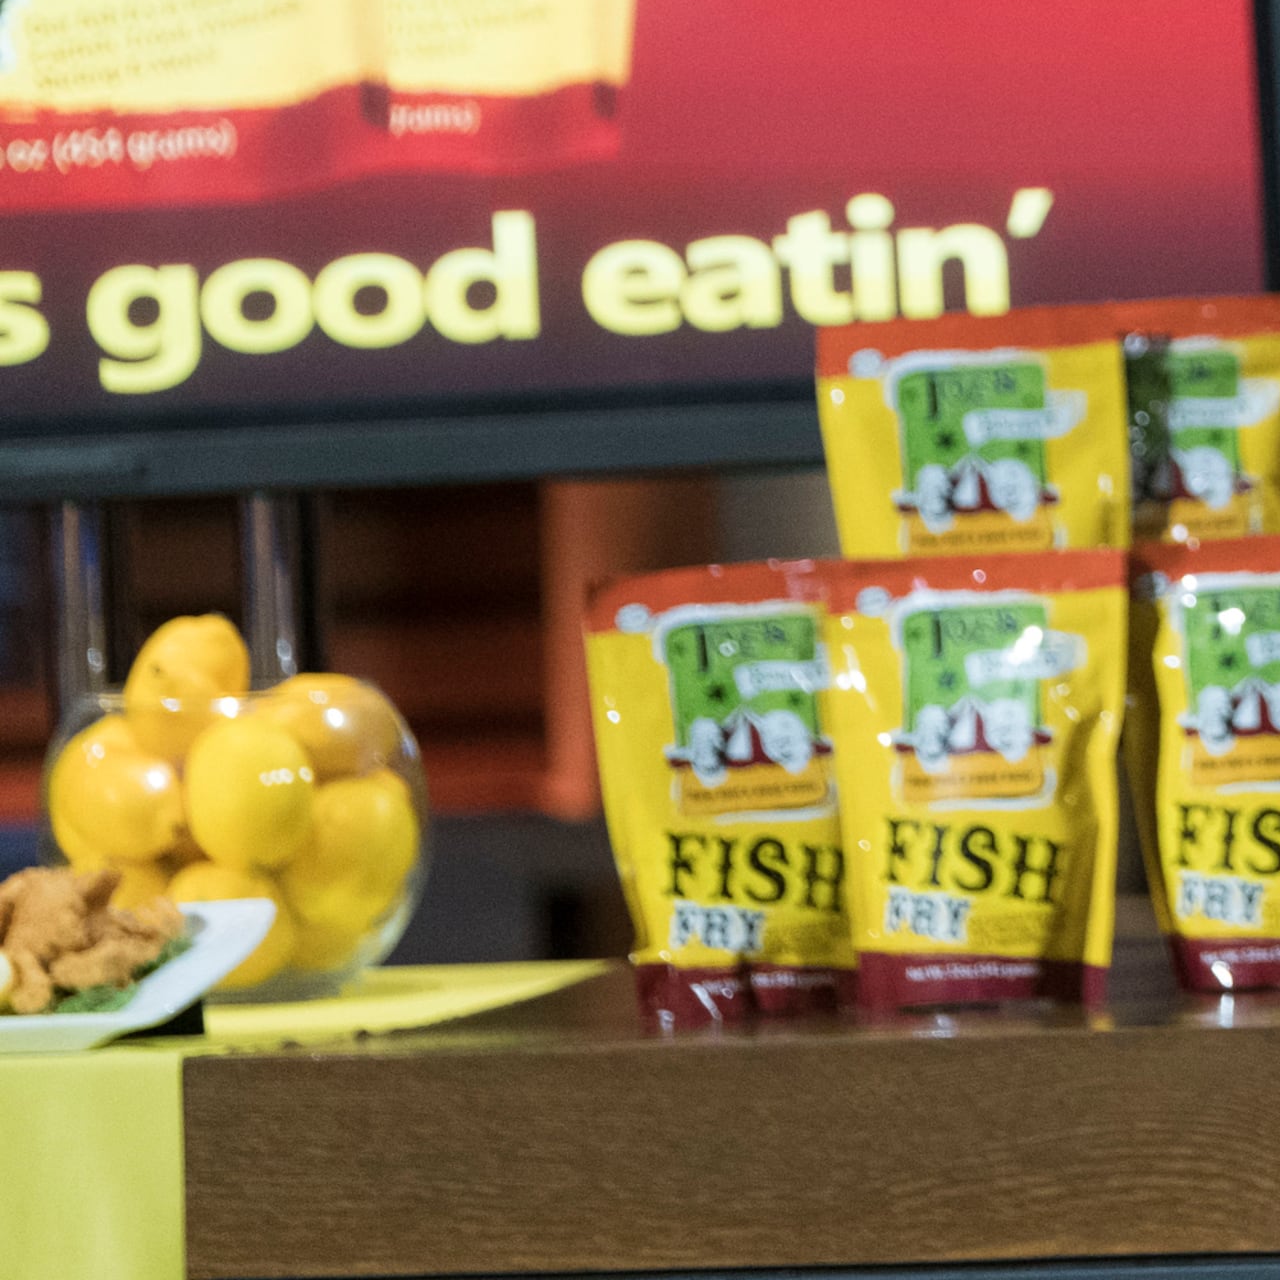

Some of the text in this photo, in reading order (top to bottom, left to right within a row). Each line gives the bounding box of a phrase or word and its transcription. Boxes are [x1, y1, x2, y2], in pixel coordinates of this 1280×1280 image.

[86, 210, 541, 394] good
[581, 187, 1053, 337] eatin'
[664, 830, 847, 914] FISH
[881, 818, 1064, 904] FISH
